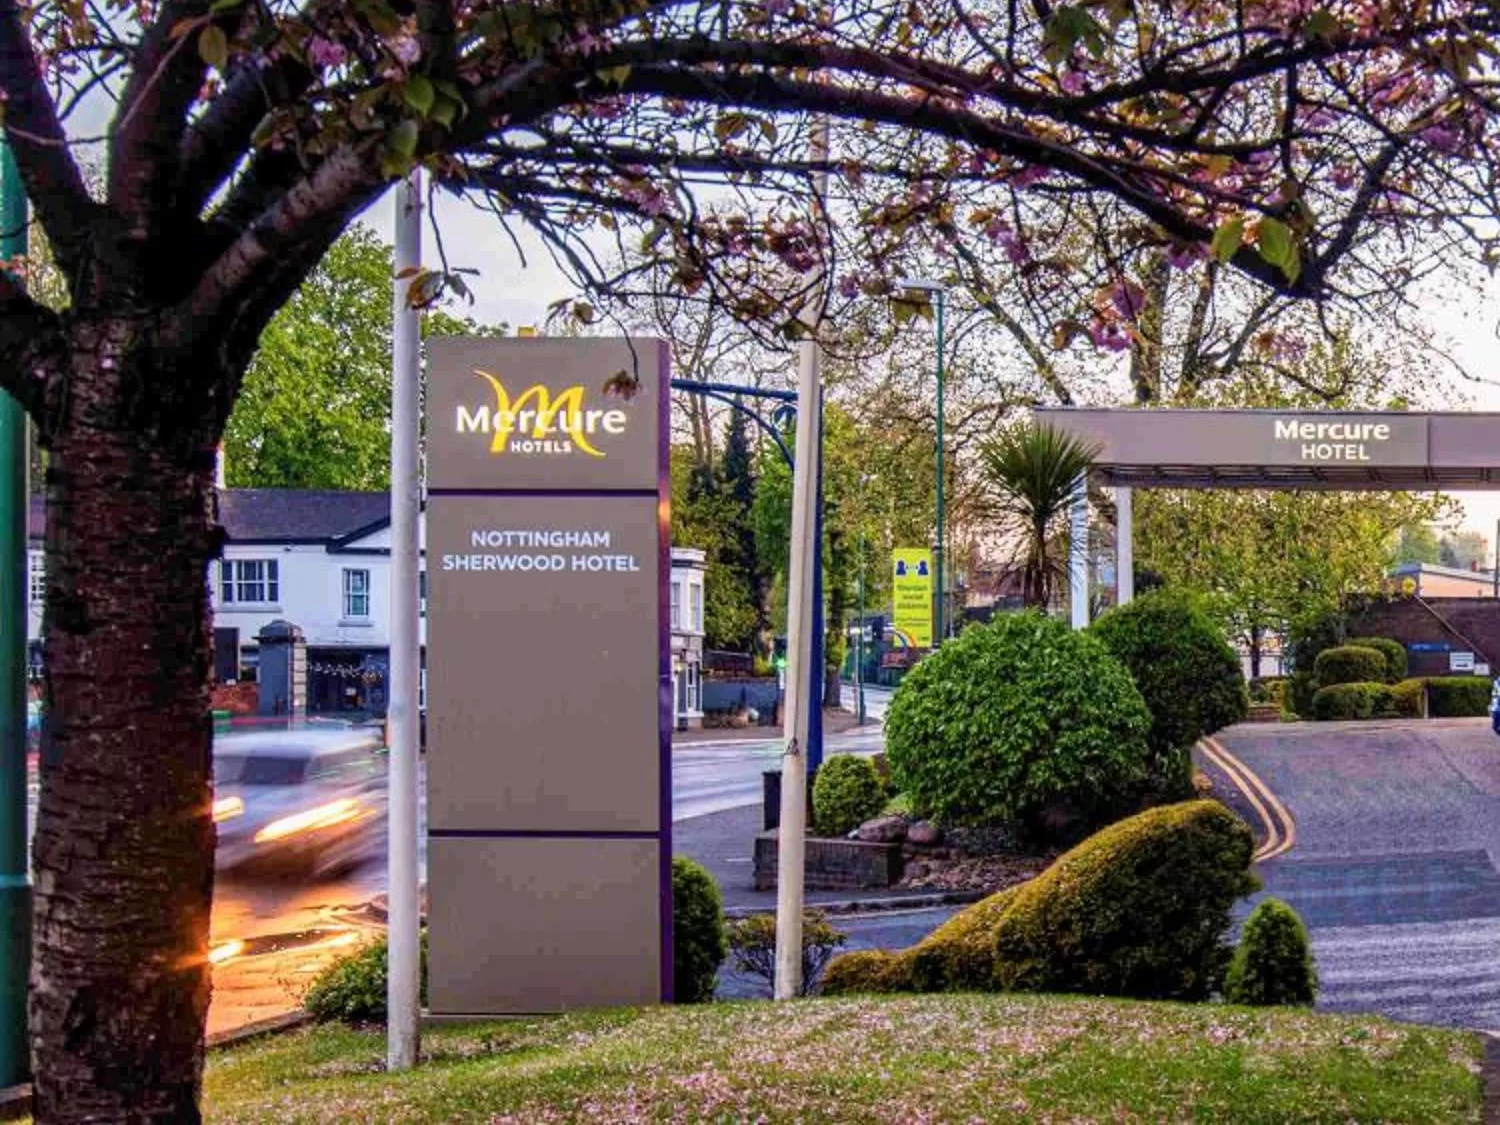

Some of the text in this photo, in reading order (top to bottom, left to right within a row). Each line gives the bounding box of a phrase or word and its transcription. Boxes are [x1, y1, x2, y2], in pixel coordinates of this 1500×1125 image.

[456, 405, 627, 434] Mercure
[1274, 420, 1390, 440] Mercure
[510, 439, 572, 454] HOTELS
[1301, 443, 1371, 460] HOTEL
[471, 530, 610, 548] NOTTINGHAM
[442, 554, 640, 572] SHERWOOD HOTEL
